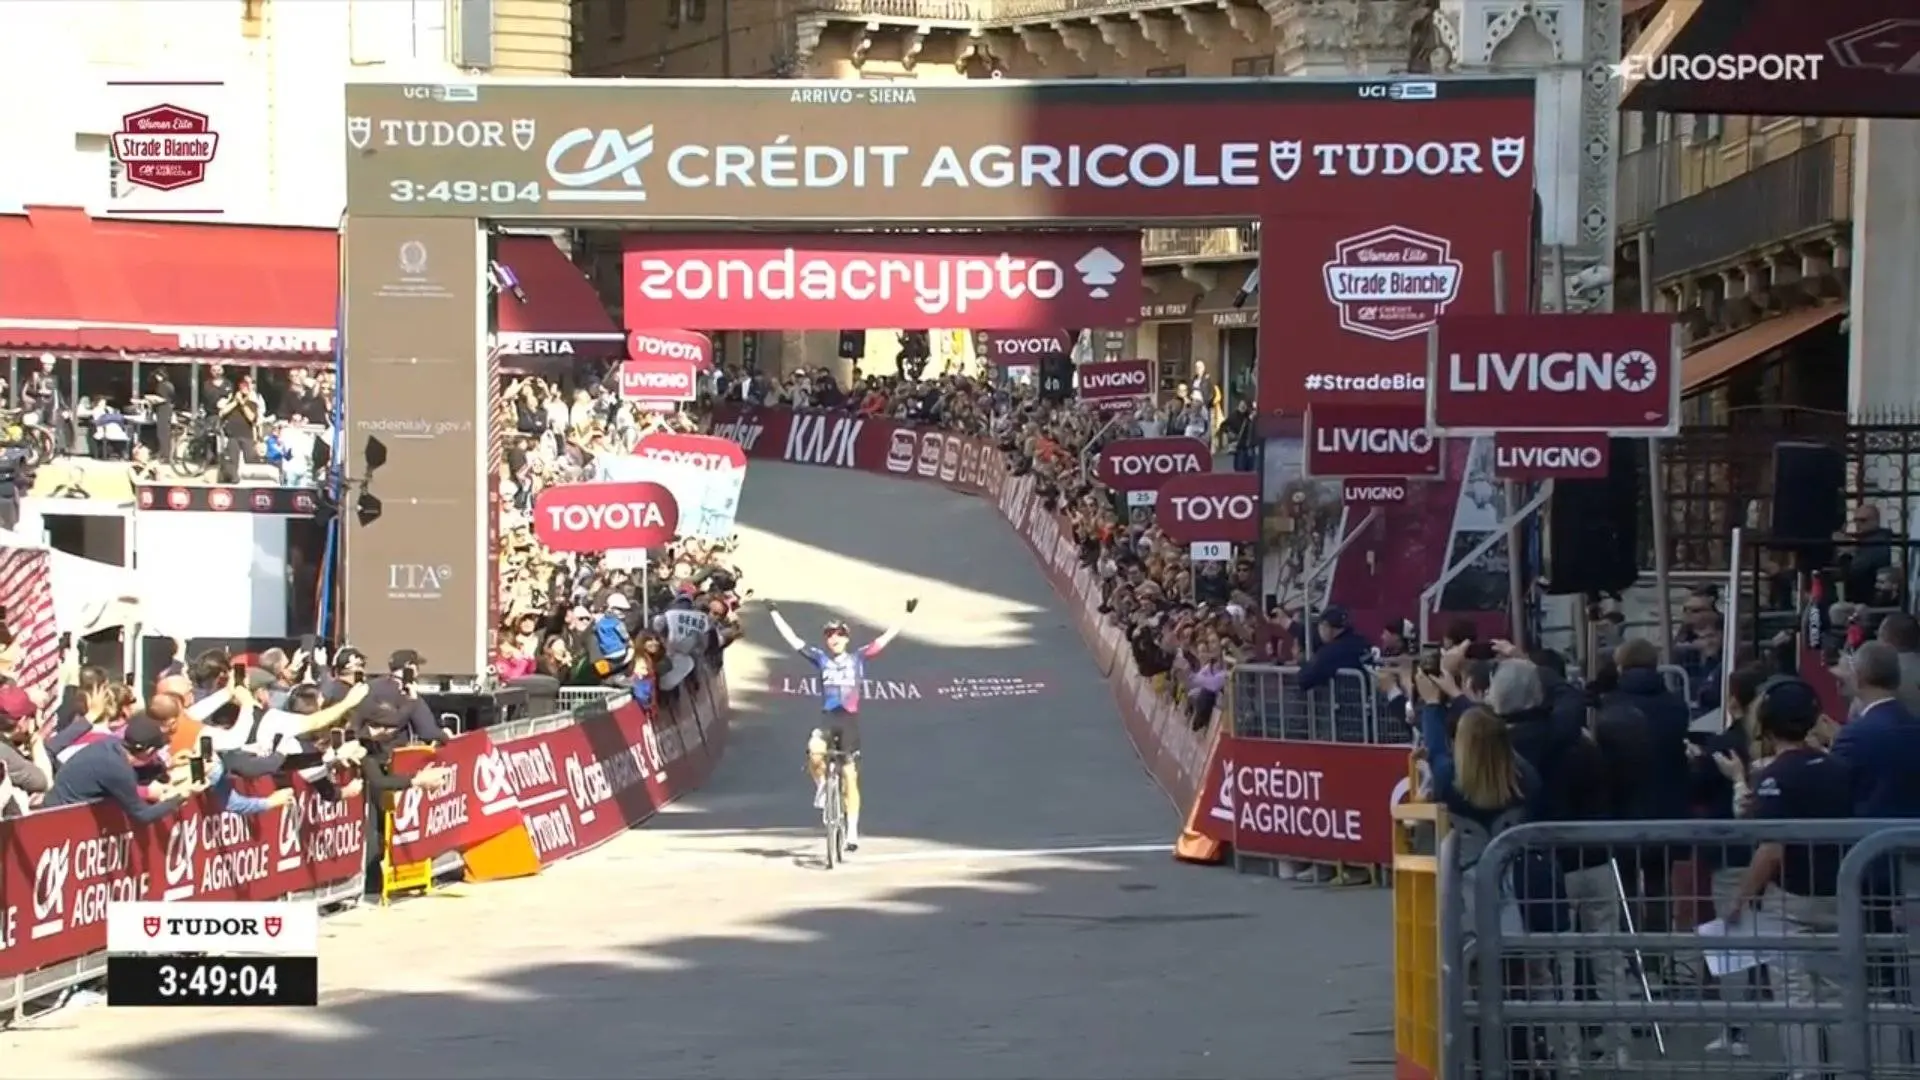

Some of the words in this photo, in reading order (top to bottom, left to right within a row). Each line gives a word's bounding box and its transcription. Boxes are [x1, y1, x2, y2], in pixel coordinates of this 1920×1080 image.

[404, 87, 430, 99] UCI
[790, 88, 852, 103] ARRIVO
[869, 88, 917, 104] SIENA
[1358, 85, 1386, 97] UCI
[380, 119, 506, 147] TUDOR
[667, 135, 909, 187] CRÉDIT
[921, 143, 1260, 188] AGRICOLE
[1312, 142, 1484, 178] TUDOR
[390, 180, 541, 203] 3:49:04
[1356, 249, 1400, 263] Women
[1402, 247, 1428, 263] Elite
[639, 248, 1064, 314] zondacrypto
[1338, 272, 1387, 295] Strade
[1390, 271, 1448, 295] Bianche
[1166, 304, 1187, 316] ITALY
[178, 331, 333, 351] RISTORANTE
[637, 335, 703, 361] TOYOTA
[995, 338, 1062, 353] TOYOTA
[624, 372, 689, 388] LIVIGNO
[1083, 370, 1146, 388] LIVIGNO
[1449, 351, 1657, 391] LIVIGNO
[1317, 427, 1434, 453] LIVIGNO
[1109, 453, 1201, 475] TOYOTA
[1497, 447, 1602, 469] LIVIGNO
[1345, 486, 1404, 500] LIVIGNO
[546, 502, 666, 532] TOYOTA
[1171, 495, 1259, 521] TOYO
[1203, 544, 1219, 556] 10
[388, 564, 441, 589] ITA
[782, 676, 922, 700] LAUTANA
[1237, 761, 1324, 801] CRÉDIT
[1240, 802, 1362, 841] AGRICOLE
[306, 819, 362, 864] AGRICOLE
[74, 827, 134, 881] CRÉDIT
[200, 843, 269, 893] AGRICOLE
